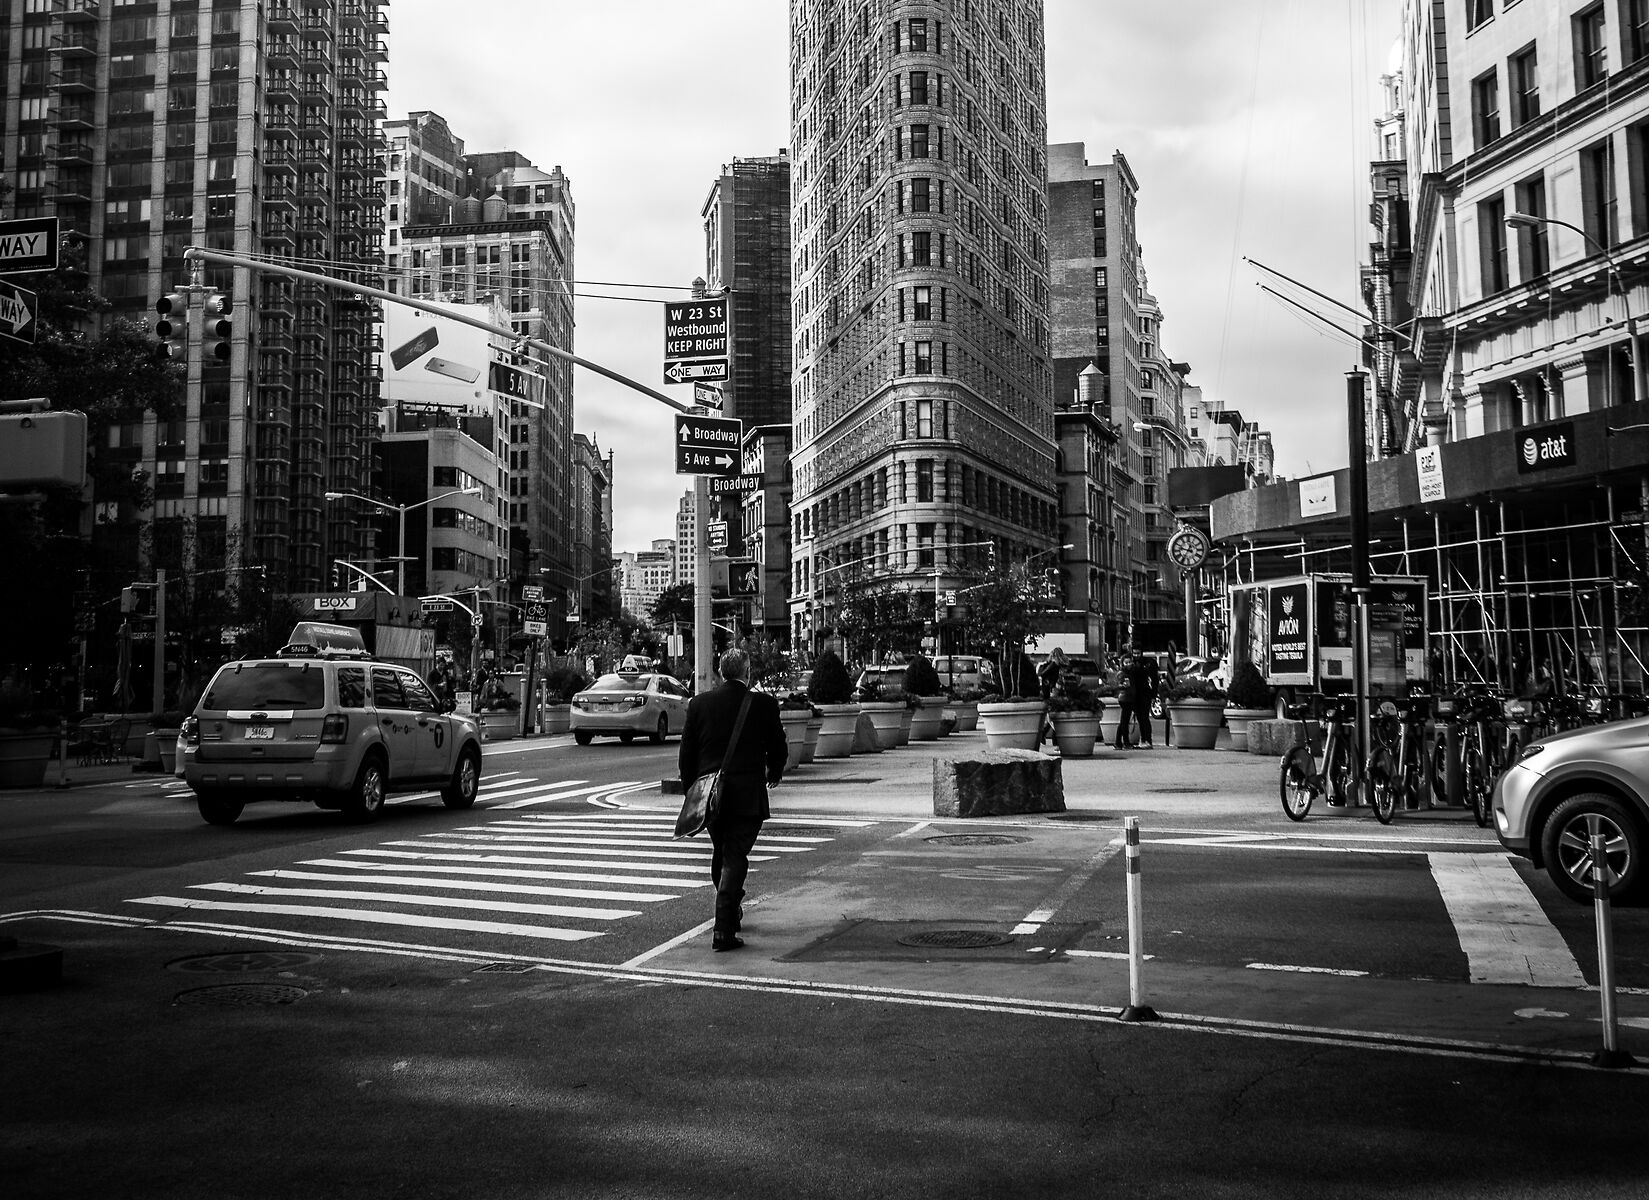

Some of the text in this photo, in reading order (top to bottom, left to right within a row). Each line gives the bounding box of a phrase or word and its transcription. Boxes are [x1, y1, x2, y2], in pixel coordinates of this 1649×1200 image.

[0, 235, 38, 257] WAY
[1, 297, 25, 324] WAY
[671, 305, 722, 320] W 23 St
[667, 321, 725, 337] Westbound
[667, 338, 725, 352] KEEP RIGHT
[670, 365, 722, 378] ONE WAY
[509, 373, 528, 396] 5 Av
[696, 388, 706, 400] ONE
[694, 427, 739, 445] Broadway
[1541, 435, 1567, 459] at&t
[684, 453, 710, 465] 5 Ave
[714, 476, 760, 492] Broadway
[320, 597, 350, 607] BOX
[1278, 616, 1299, 635] AVIÓN
